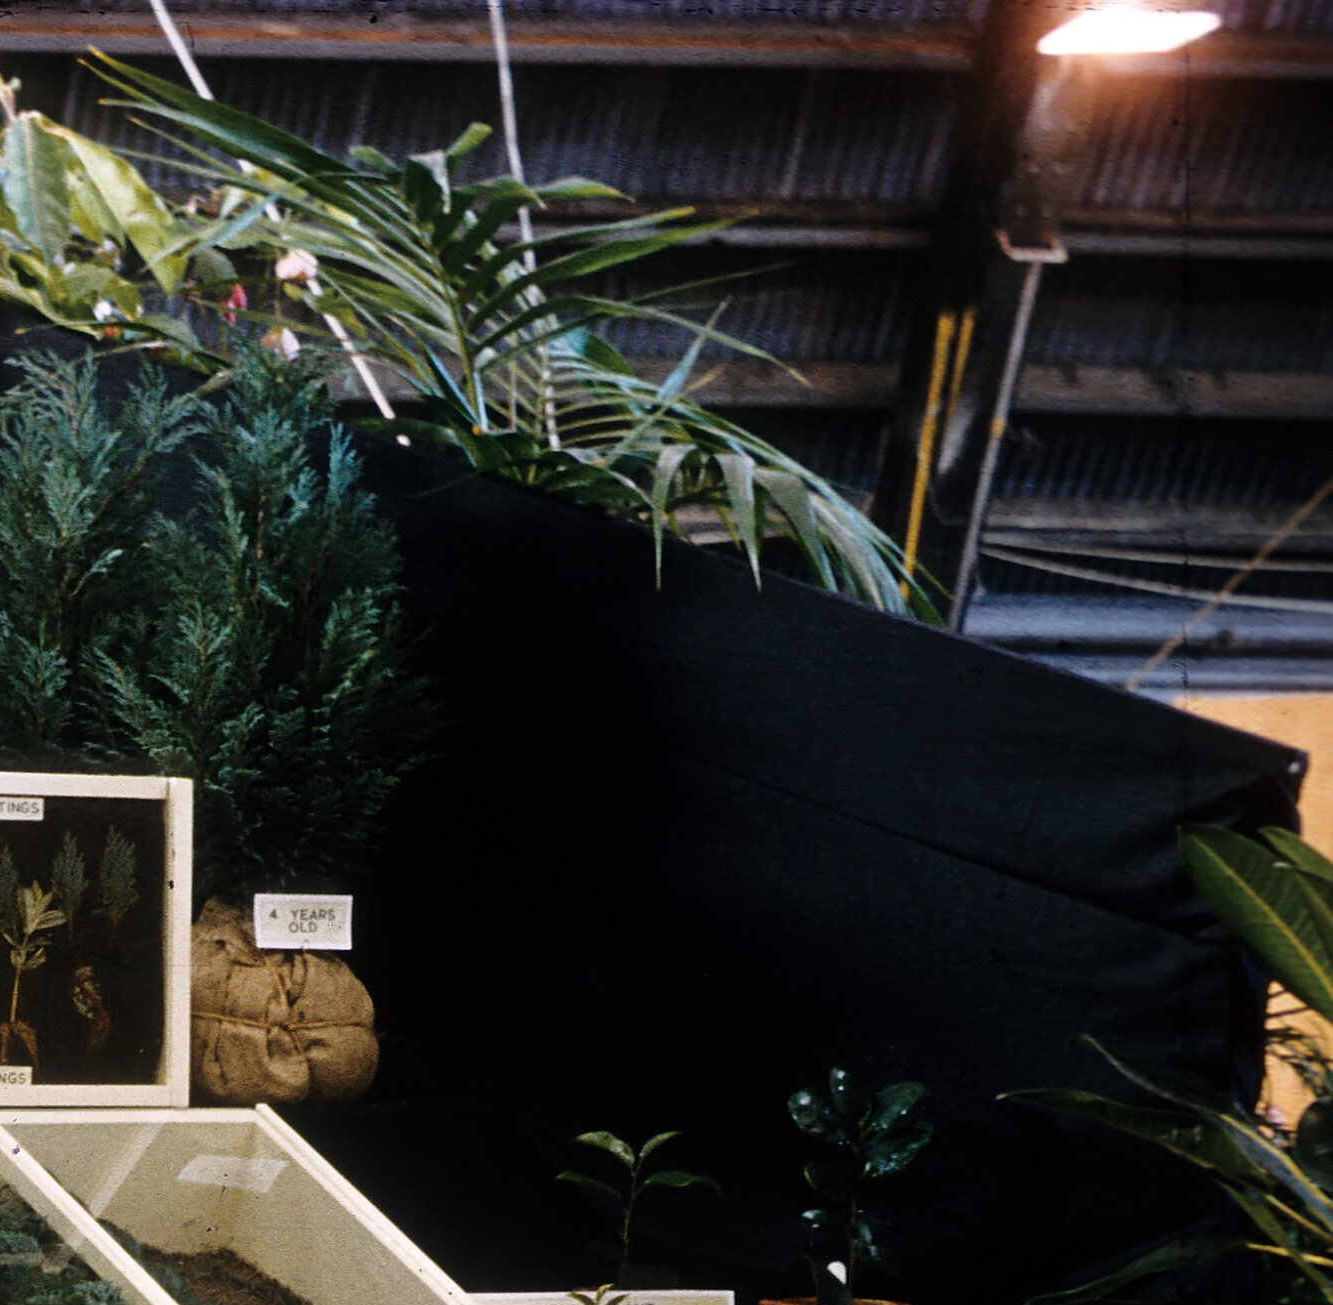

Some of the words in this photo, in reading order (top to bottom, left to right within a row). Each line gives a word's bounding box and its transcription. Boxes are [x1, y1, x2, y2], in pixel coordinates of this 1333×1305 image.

[269, 908, 278, 919] 4
[290, 908, 336, 921] YEARS
[288, 922, 318, 933] OLD
